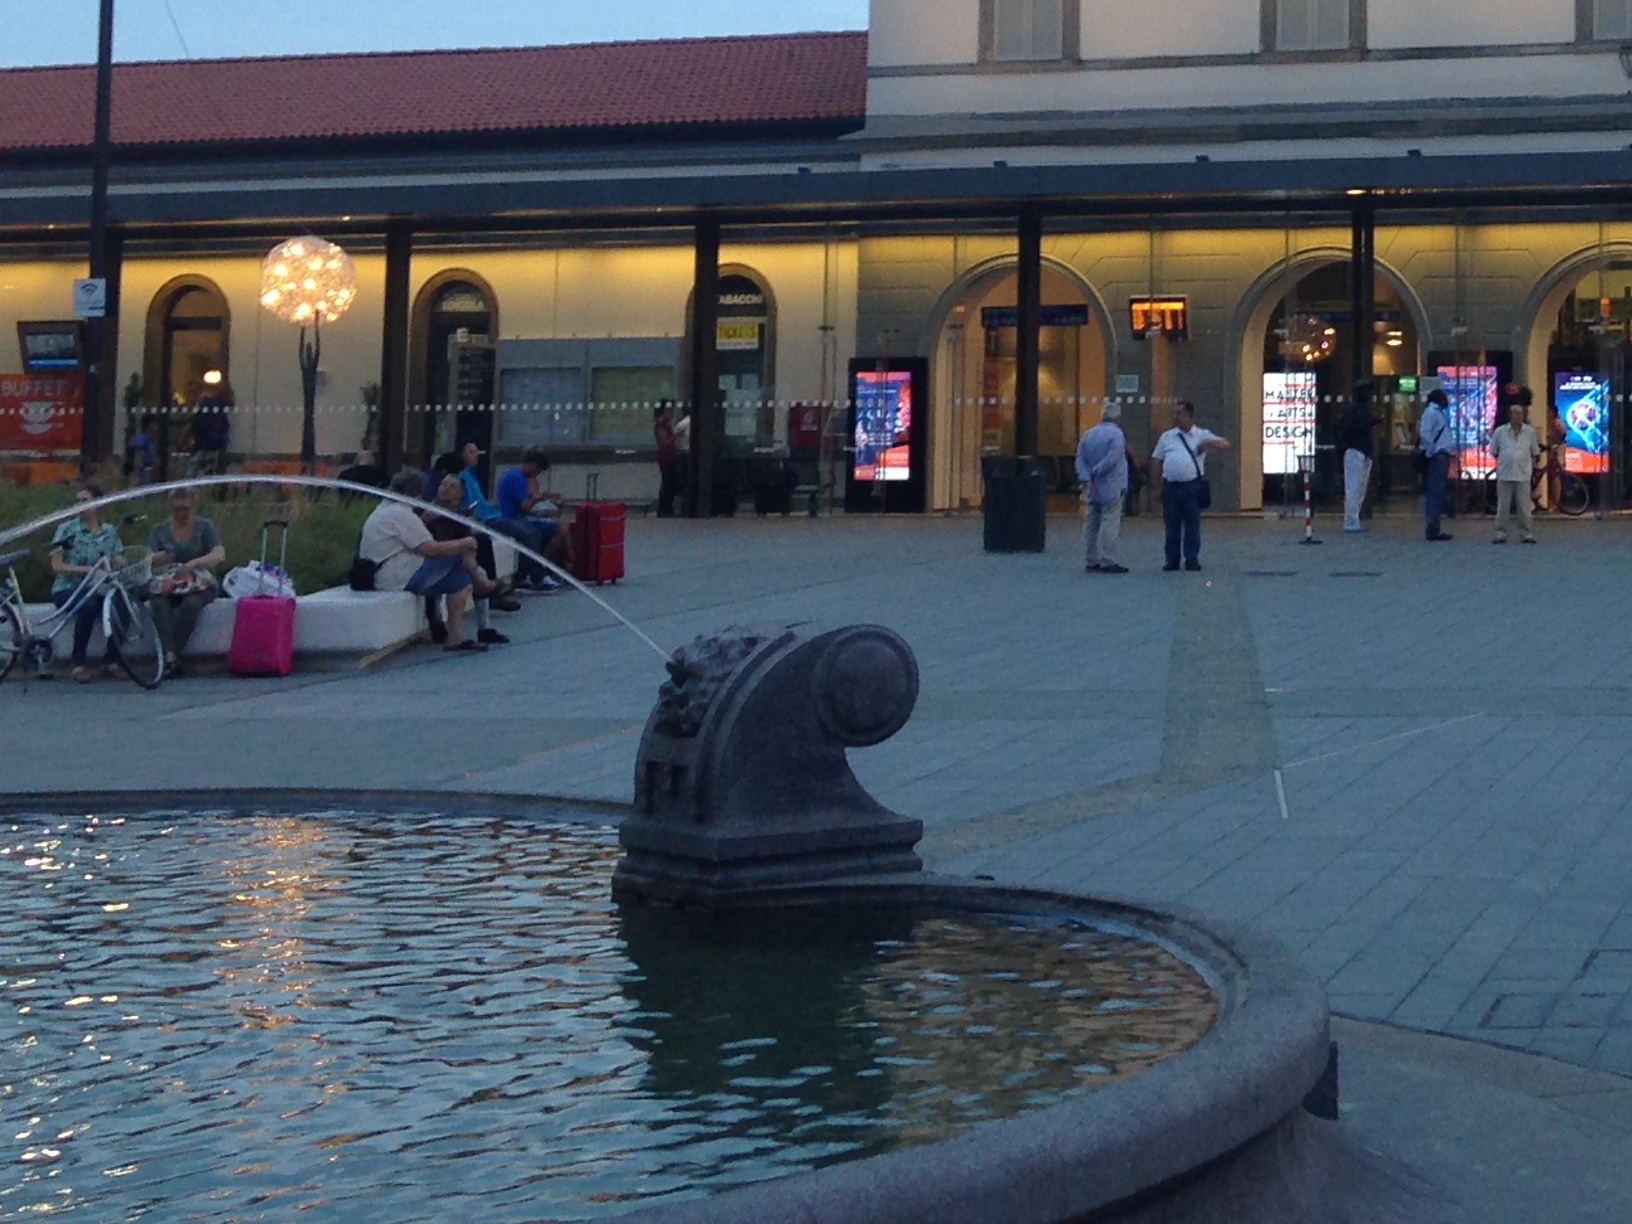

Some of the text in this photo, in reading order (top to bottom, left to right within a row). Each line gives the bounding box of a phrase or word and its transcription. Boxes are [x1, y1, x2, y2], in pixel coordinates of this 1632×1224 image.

[718, 294, 763, 305] ABACCHI
[2, 380, 65, 397] BUFFET
[1265, 426, 1313, 438] DESIGN
